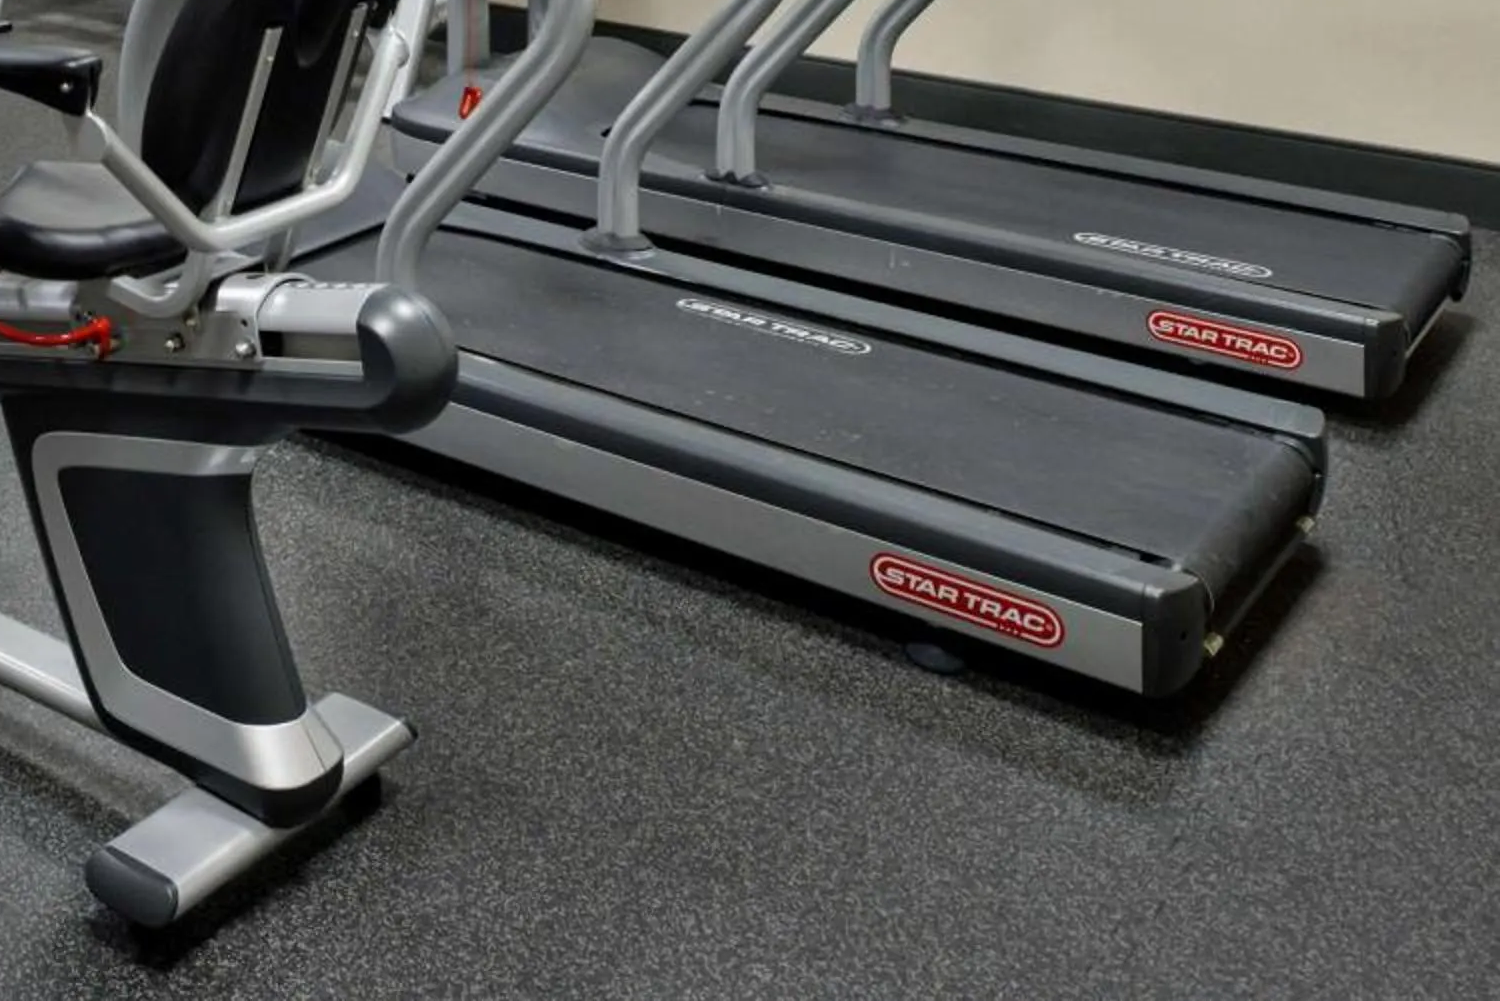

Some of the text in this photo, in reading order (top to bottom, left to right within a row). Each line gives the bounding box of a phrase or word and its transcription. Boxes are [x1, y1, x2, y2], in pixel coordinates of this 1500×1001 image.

[685, 300, 861, 351] STAR TRAC
[1158, 318, 1288, 360] STAR TRAC
[884, 565, 1046, 634] STAR TRAC
